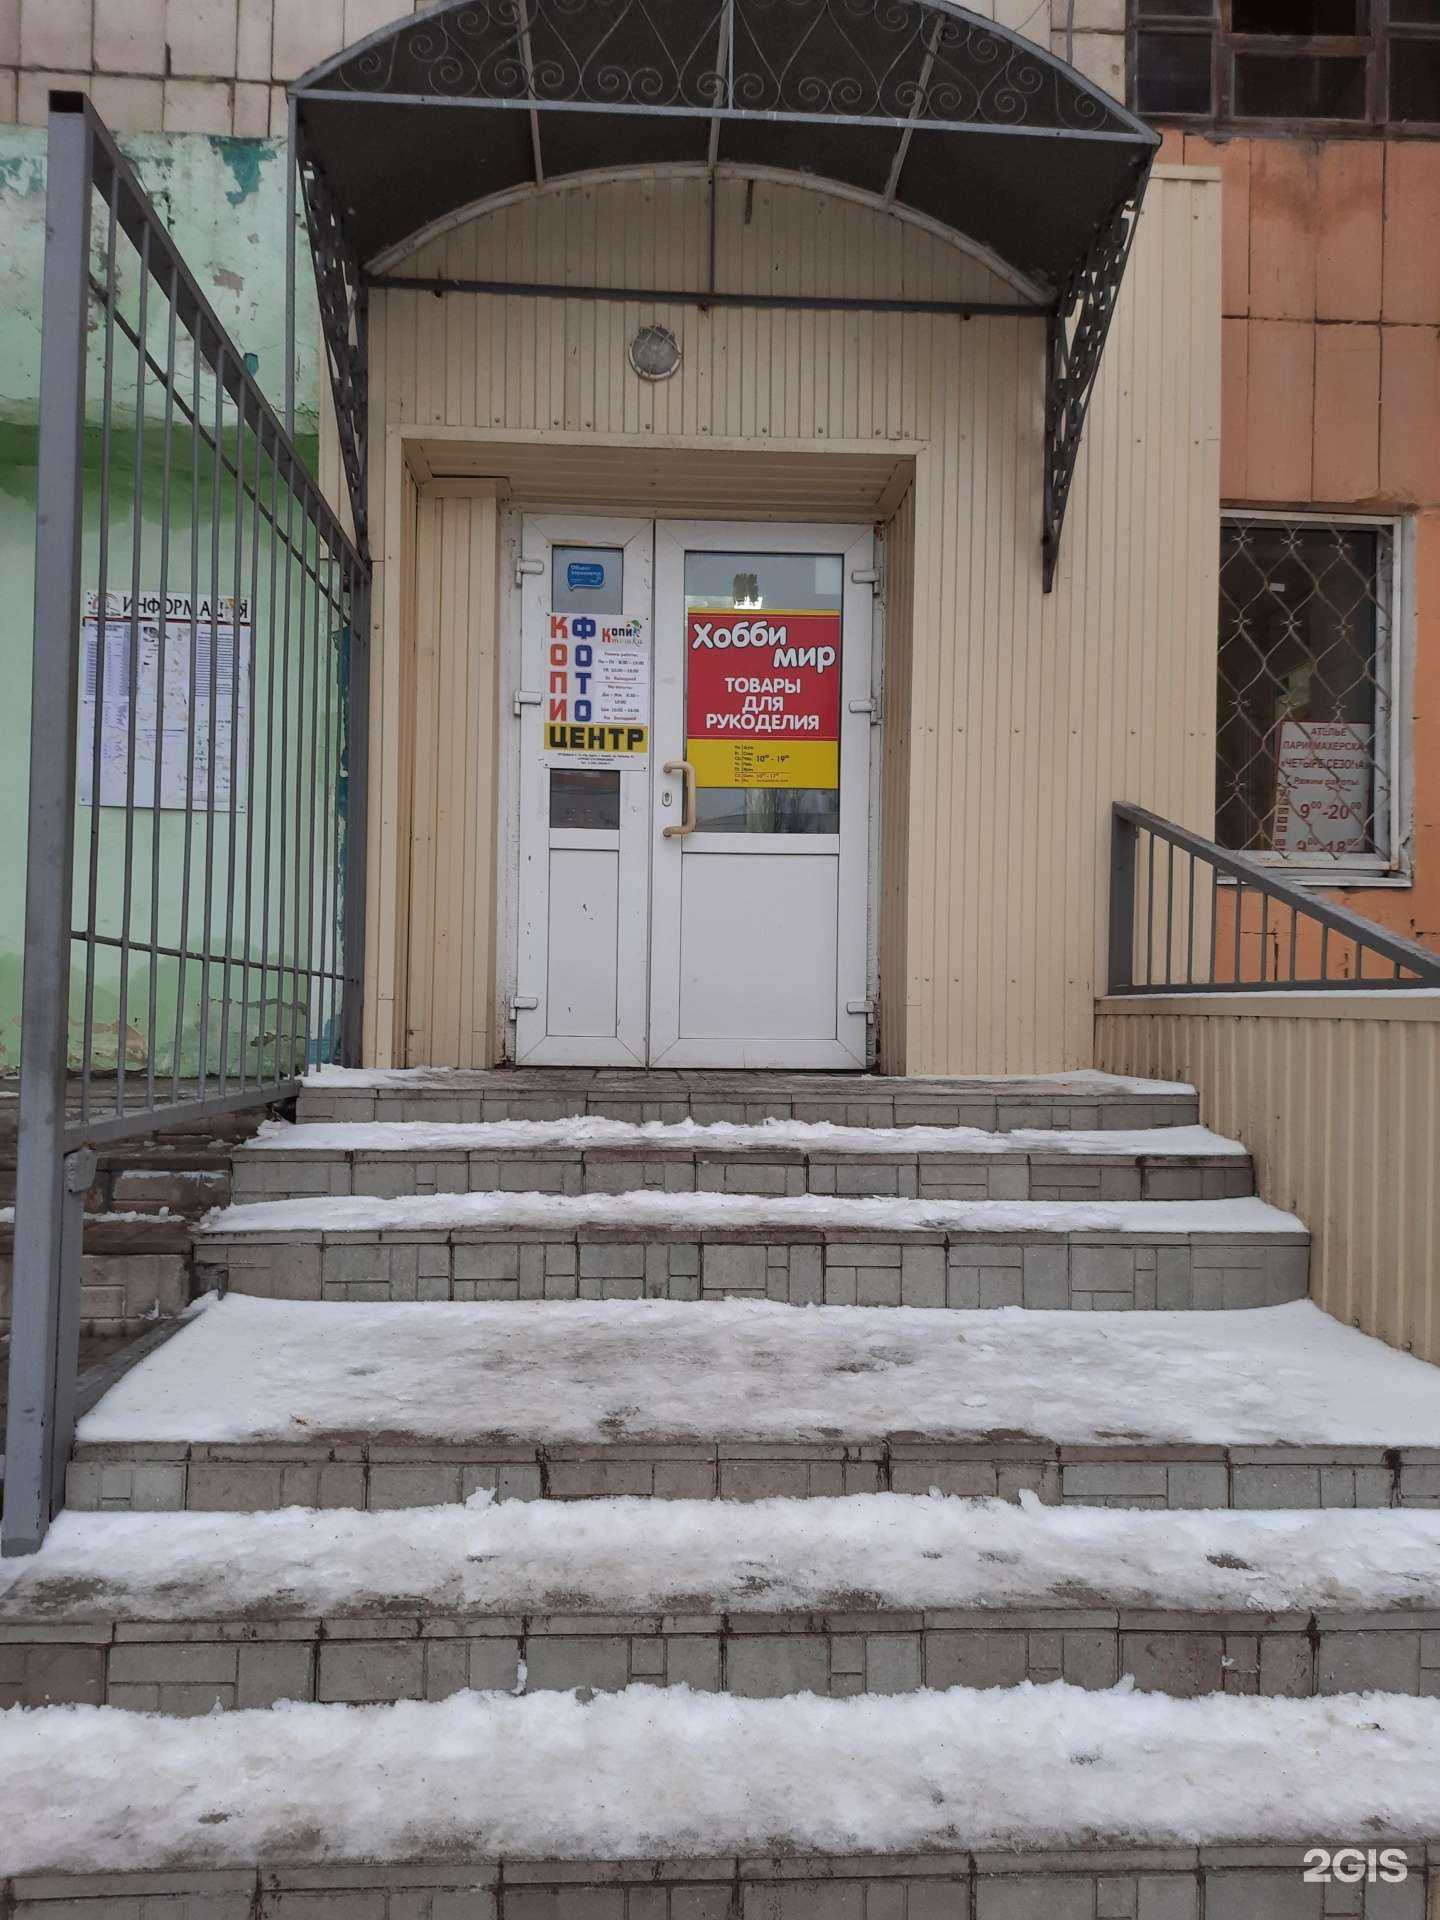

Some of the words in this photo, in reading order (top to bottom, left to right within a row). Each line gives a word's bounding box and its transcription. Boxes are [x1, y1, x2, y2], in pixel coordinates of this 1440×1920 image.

[123, 597, 248, 618] ИНФОРМАЯ
[692, 621, 787, 649] Хобби
[773, 646, 836, 674] мир
[724, 677, 801, 694] ТОВАРЫ
[741, 695, 784, 714] ДЛЯ
[705, 713, 820, 733] РУКОДЕЛИЯ
[549, 726, 644, 751] ЦЕНТР
[1282, 740, 1368, 753] ПАРИМАХЕРСКА
